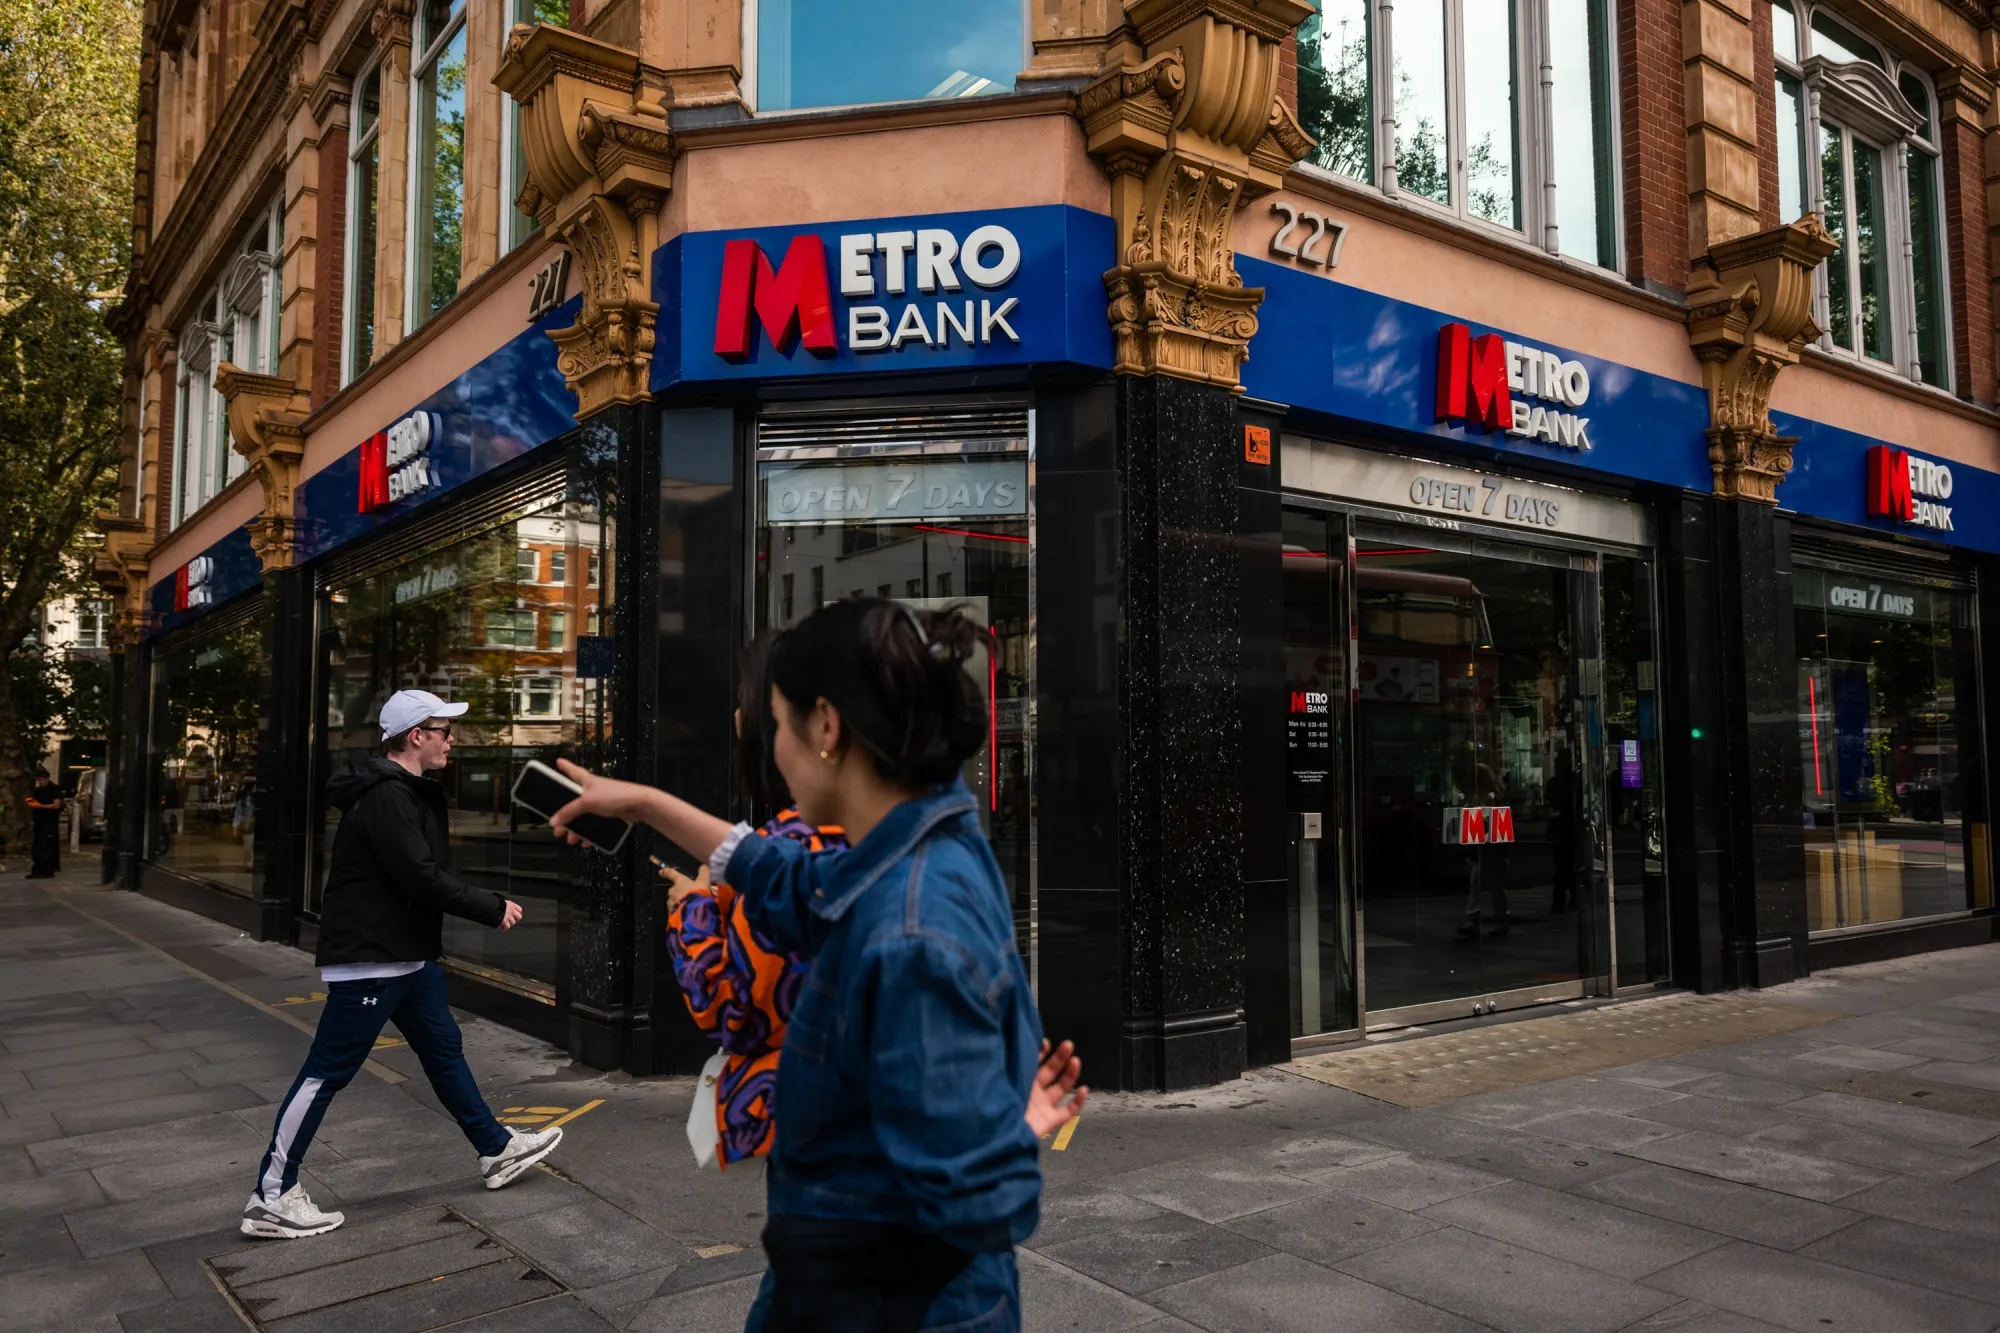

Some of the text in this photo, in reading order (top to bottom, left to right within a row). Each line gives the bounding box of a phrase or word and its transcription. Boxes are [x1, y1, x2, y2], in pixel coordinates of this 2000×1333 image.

[1268, 201, 1350, 269] 227
[526, 250, 572, 323] 227
[714, 224, 1020, 357] METRO
[849, 297, 1020, 350] BANK
[1436, 322, 1590, 429] METRO
[1506, 400, 1591, 450] BANK
[777, 471, 1017, 514] OPEN 7 DAYS
[1409, 476, 1561, 527] OPEN 7 DAYS
[1867, 445, 1953, 521] METRO
[1905, 498, 1954, 531] BANK
[1830, 583, 1914, 616] OPEN 7 DAYS
[1291, 691, 1328, 713] METRO
[1307, 704, 1328, 713] BANK
[1460, 806, 1515, 845] M M
